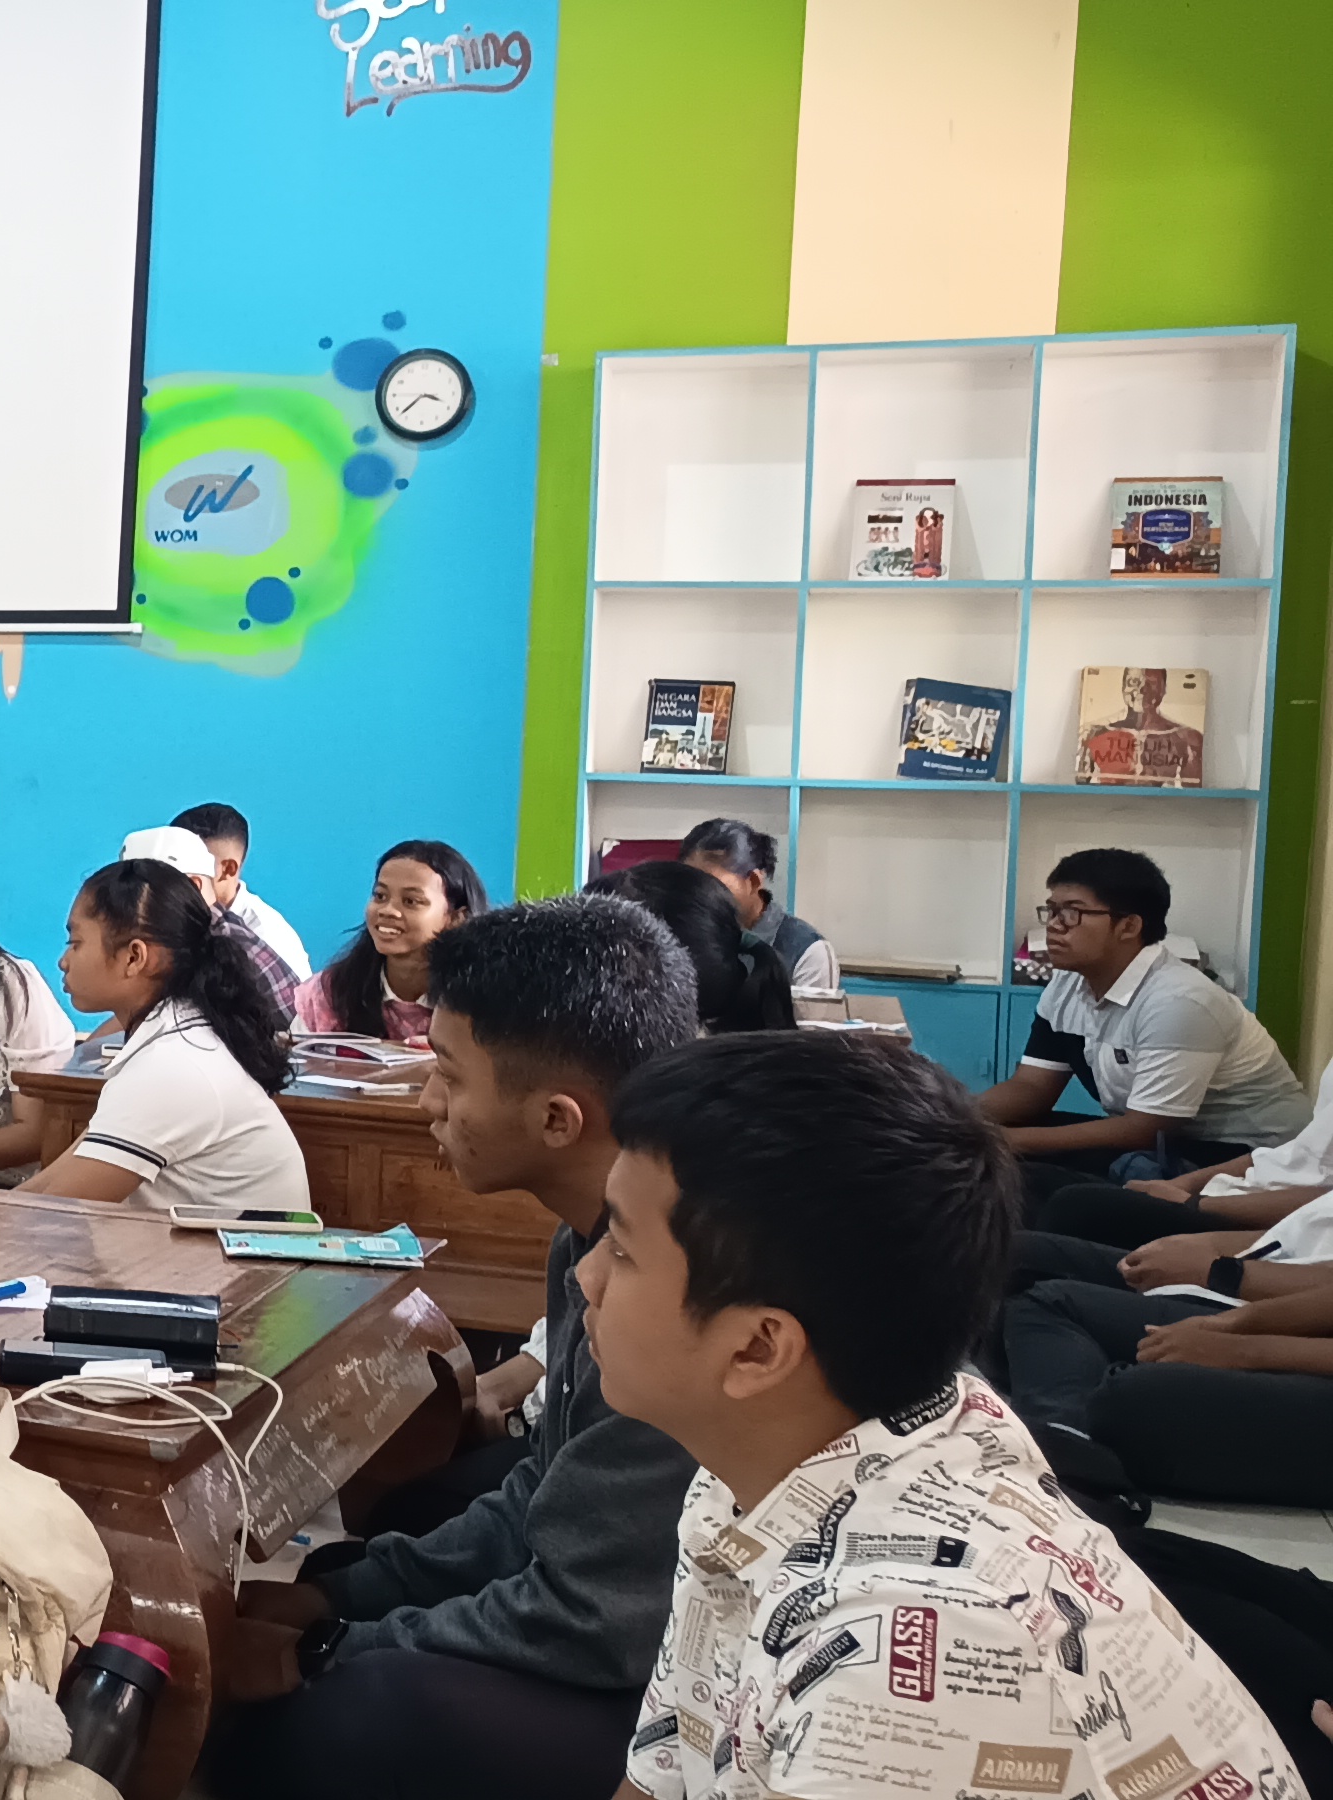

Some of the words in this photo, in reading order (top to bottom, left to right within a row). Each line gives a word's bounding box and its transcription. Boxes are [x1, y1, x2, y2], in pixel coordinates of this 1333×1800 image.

[345, 24, 532, 117] Learning
[1127, 493, 1208, 506] INDONESIA
[154, 529, 198, 543] WOM
[656, 692, 697, 702] NEGARA
[891, 1608, 925, 1698] GLASS
[978, 1757, 1061, 1783] AIRMAIL
[1118, 1752, 1185, 1800] AIRMAIL
